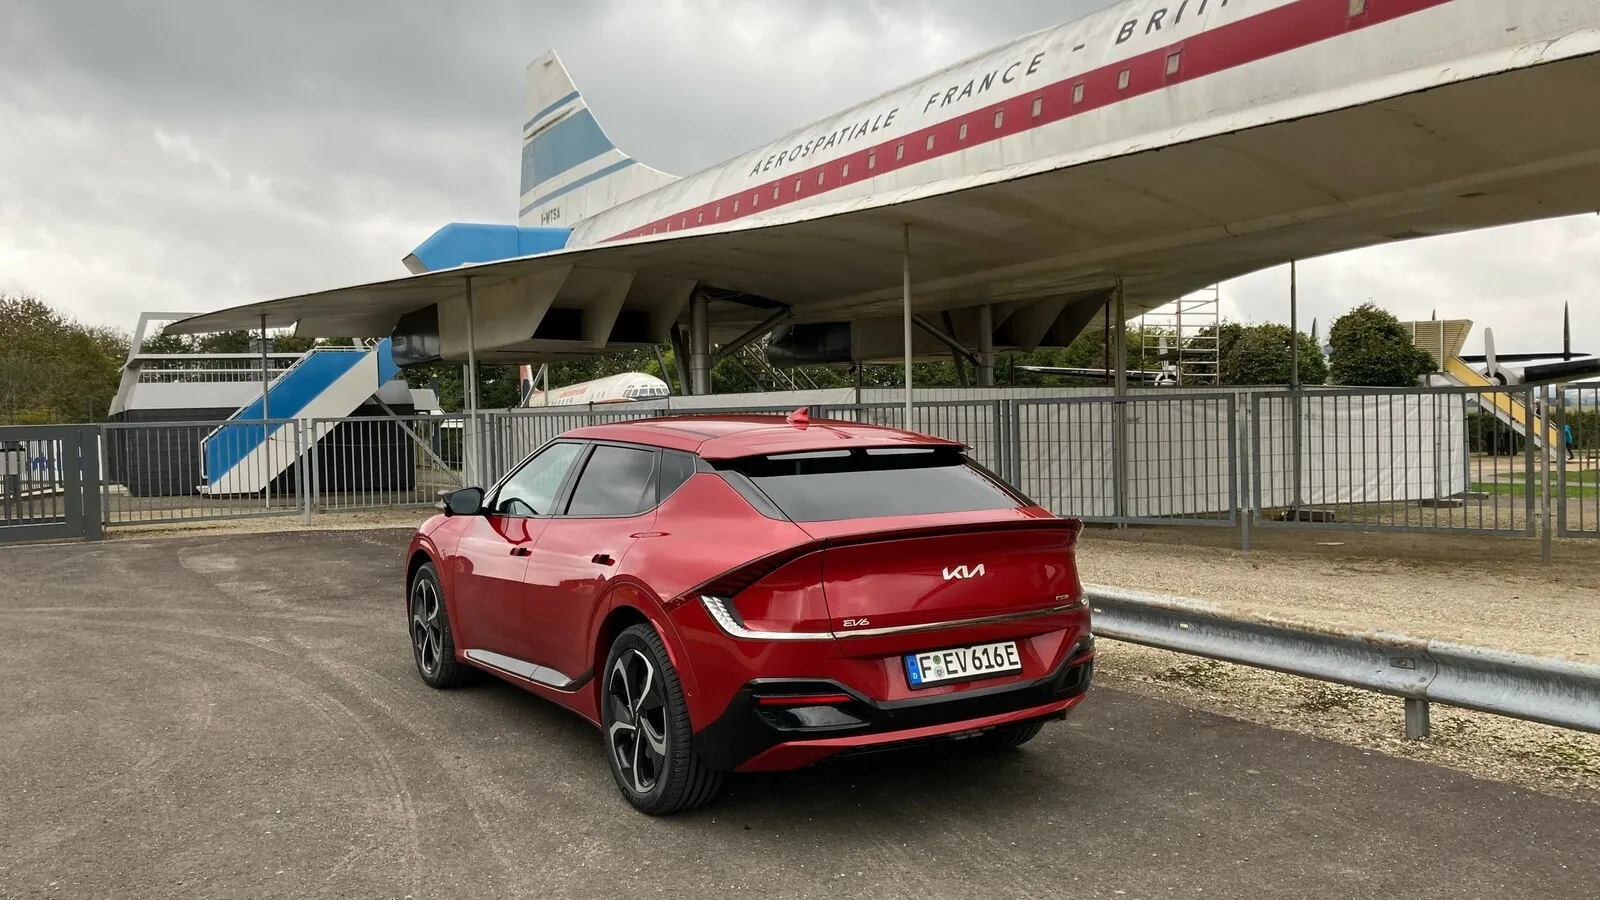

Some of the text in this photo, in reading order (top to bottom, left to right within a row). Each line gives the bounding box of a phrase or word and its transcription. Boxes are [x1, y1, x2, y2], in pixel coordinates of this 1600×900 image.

[749, 107, 899, 177] AEROSPATIALE
[922, 52, 1045, 114] FRANCE
[843, 618, 870, 627] EV6
